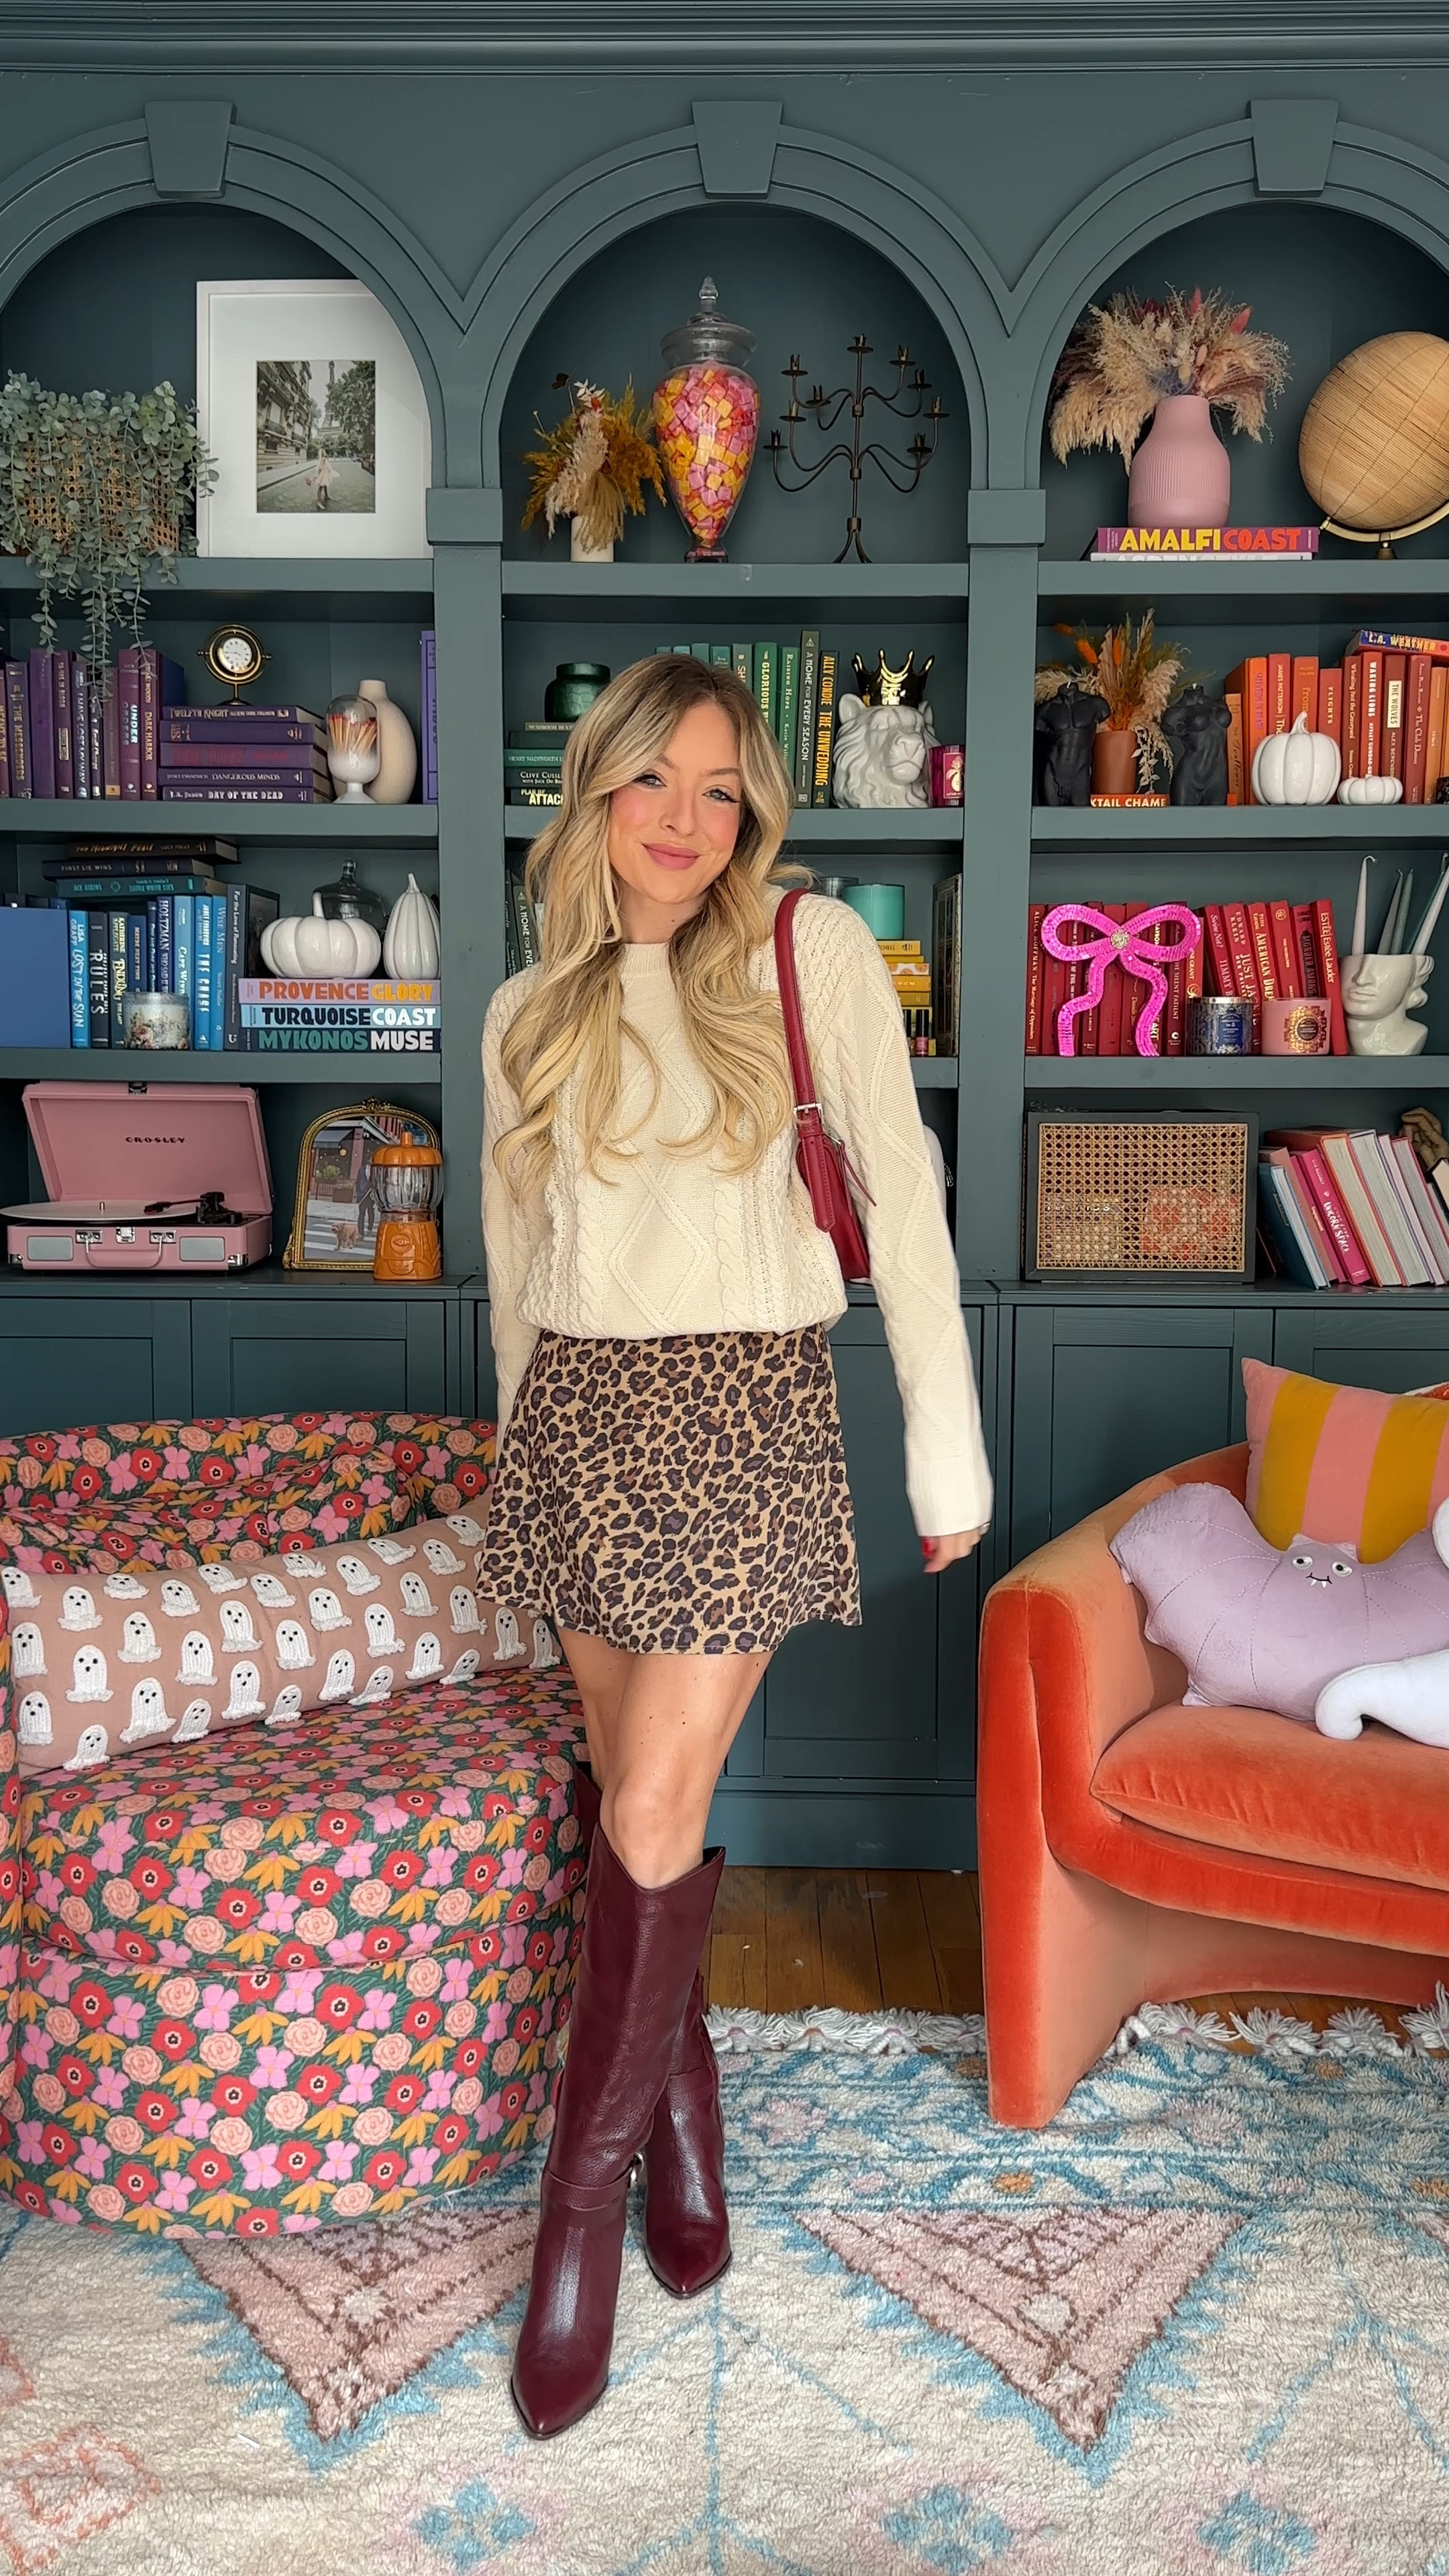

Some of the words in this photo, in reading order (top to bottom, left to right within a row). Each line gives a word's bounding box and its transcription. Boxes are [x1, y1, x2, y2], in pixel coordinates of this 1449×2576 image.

[1120, 529, 1221, 551] AMALFI
[1224, 529, 1301, 550] COAST
[1390, 635, 1436, 651] WEATHER
[804, 659, 812, 684] HOME
[822, 655, 835, 675] ALLY
[1369, 661, 1377, 692] WAKING
[761, 661, 769, 709] GLORIOUS
[820, 677, 834, 705] CONDIE
[1302, 687, 1310, 712] from
[1391, 699, 1399, 724] WOLVES
[13, 705, 23, 721] THE
[170, 708, 201, 718] TWELFTH
[203, 708, 229, 719] KNIGHT
[803, 700, 811, 725] EVERY
[819, 712, 833, 728] THE
[802, 727, 810, 760] SEASON
[815, 730, 831, 786] UNWEDDING
[208, 791, 225, 799] DAY
[227, 791, 238, 799] OF
[241, 791, 258, 799] THE
[261, 792, 283, 800] DEAD
[1091, 798, 1120, 807] KTAIL
[1125, 798, 1167, 807] CHAME
[158, 900, 169, 950] HOLTZMAN
[217, 907, 225, 930] WISE
[521, 912, 530, 936] HOME
[1230, 917, 1240, 943] KLEIN
[1236, 911, 1246, 945] EDWARD
[1320, 912, 1330, 935] ESTÉE
[217, 932, 225, 953] MEN
[231, 933, 239, 964] Renovating
[1256, 932, 1272, 976] AMERICAN
[1302, 935, 1314, 966] MURDER
[1323, 937, 1332, 957] Estée
[72, 949, 84, 975] LOST
[197, 953, 209, 973] THE
[1214, 933, 1224, 948] Not?
[1219, 960, 1233, 988] JIMMY
[1240, 953, 1253, 979] JUST
[1326, 958, 1336, 983] Lauder
[89, 953, 105, 1014] RULES
[259, 981, 368, 1000] PROVENCE
[371, 983, 433, 1001] GLORY
[1238, 972, 1246, 998] PRIVAT
[1263, 978, 1275, 999] DREA
[1306, 968, 1317, 994] AMONG
[197, 978, 209, 1012] CHASE
[73, 1004, 85, 1028] SUN
[262, 1008, 370, 1025] TURQUOISE
[372, 1008, 435, 1026] COAST
[259, 1030, 368, 1051] MYKONOS
[371, 1031, 433, 1051] MUSE
[1323, 1201, 1342, 1230] UNICORN
[1334, 1230, 1350, 1254] SPACE
